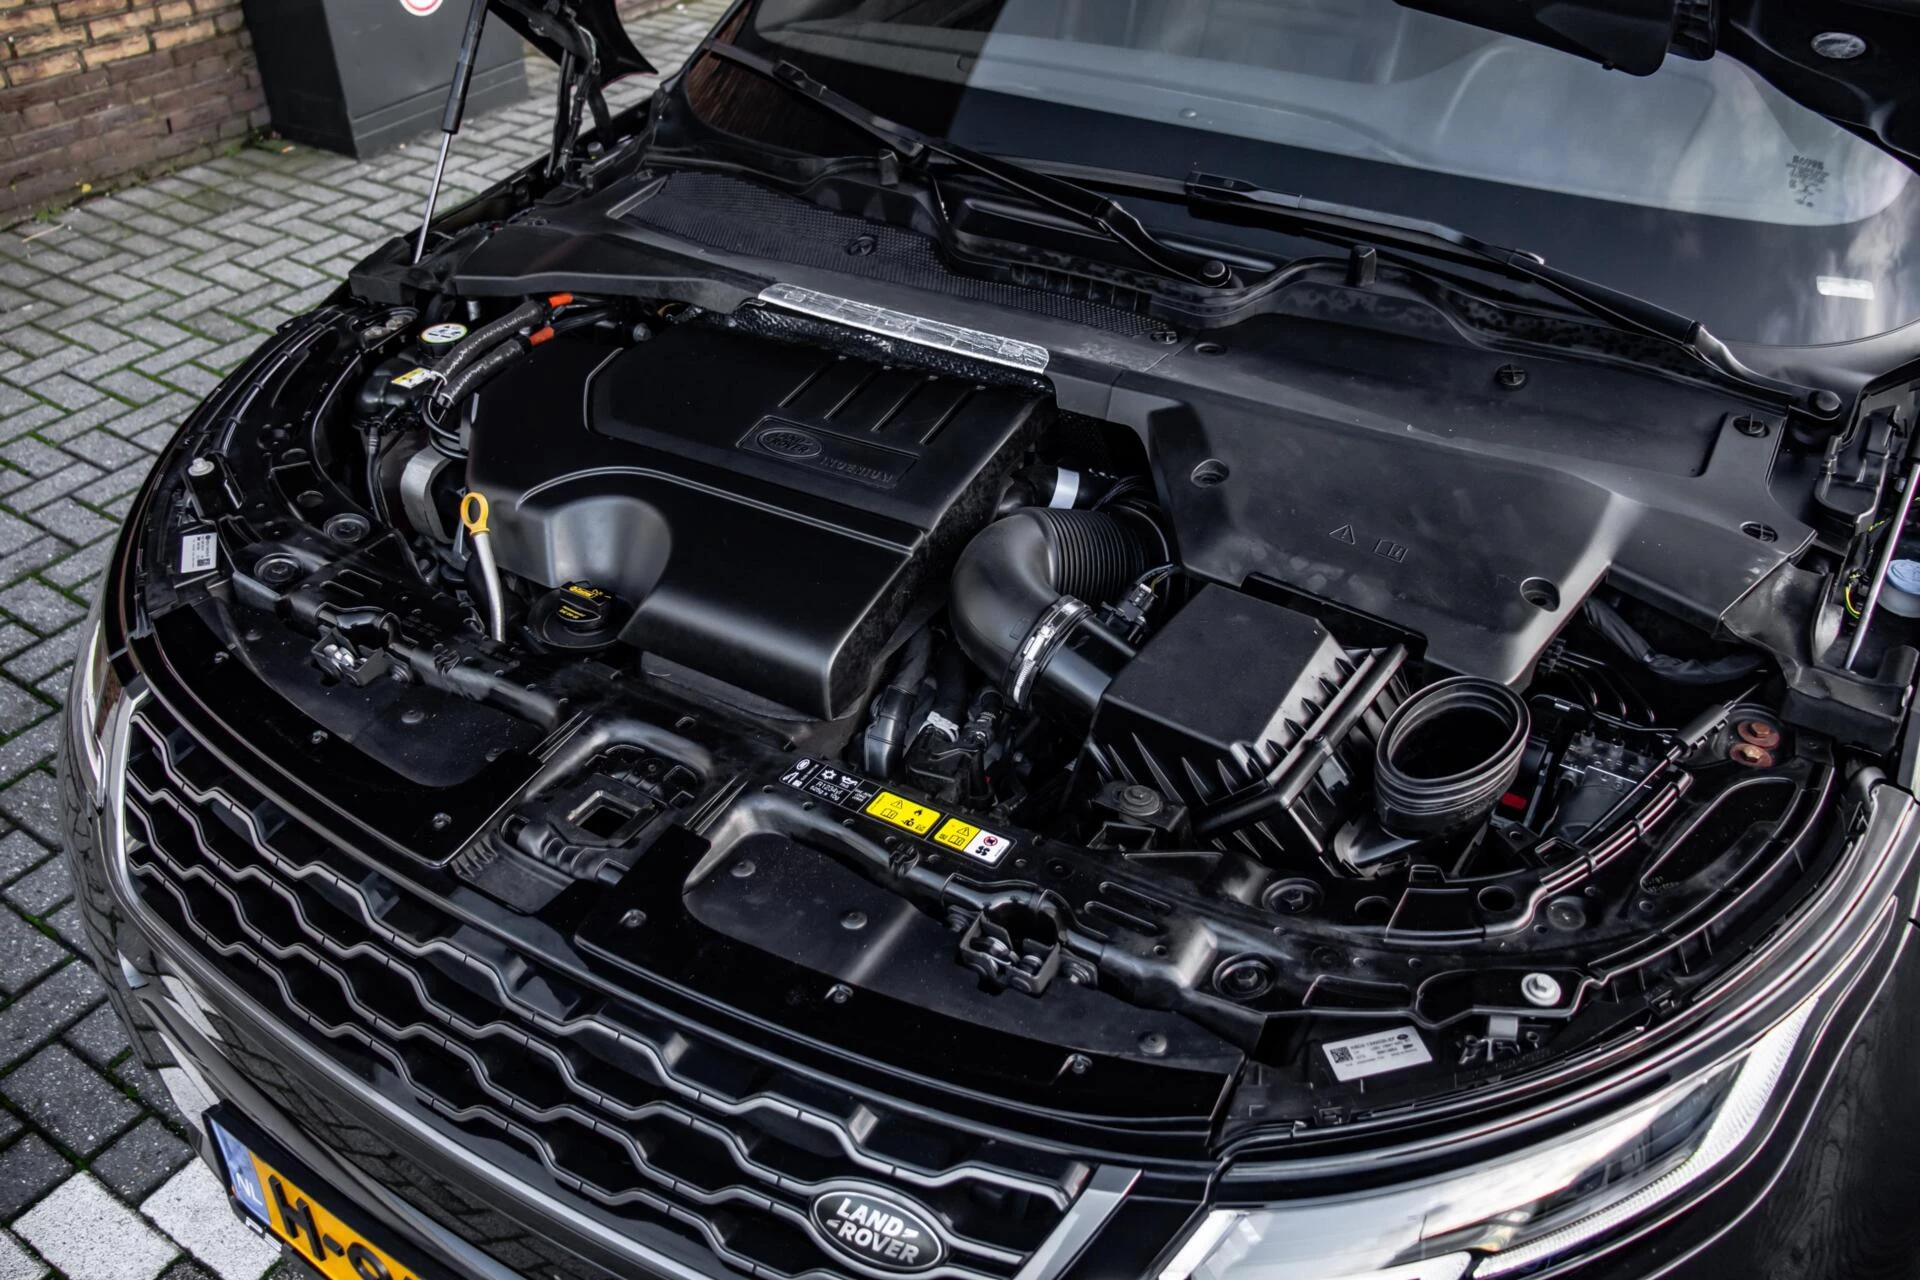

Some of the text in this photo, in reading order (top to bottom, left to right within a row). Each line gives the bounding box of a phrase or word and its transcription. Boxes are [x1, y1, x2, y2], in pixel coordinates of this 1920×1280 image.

[771, 438, 811, 454] ROVER
[235, 1172, 264, 1207] NL
[836, 1198, 904, 1238] LAND
[837, 1220, 920, 1265] ROVER
